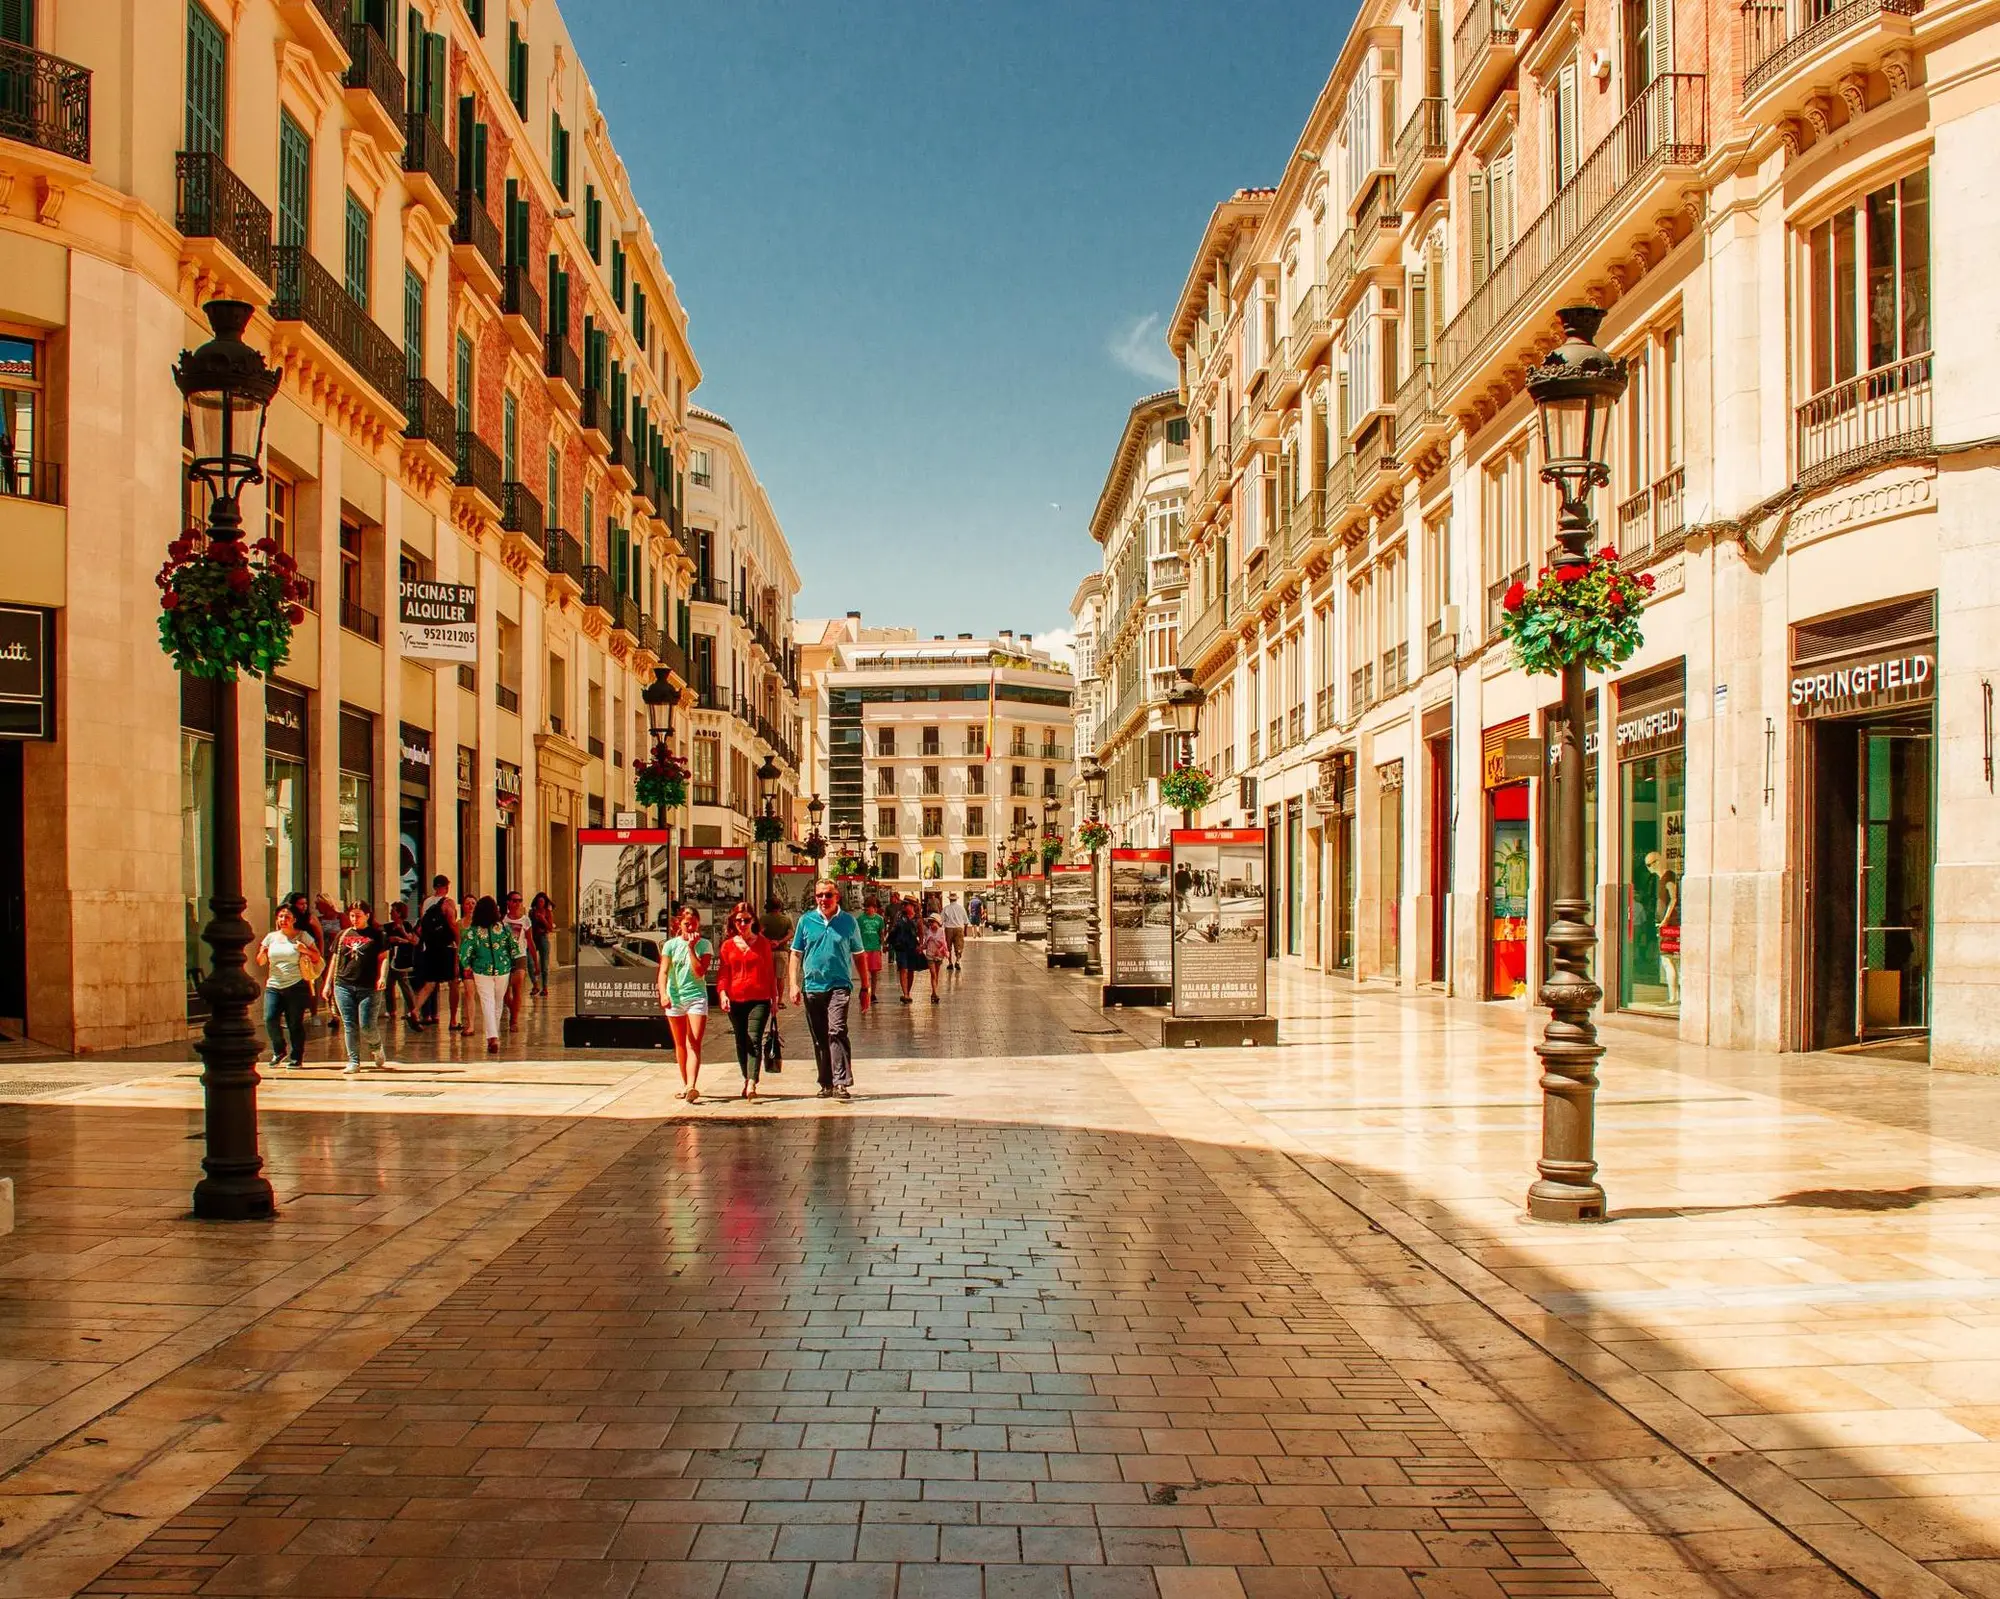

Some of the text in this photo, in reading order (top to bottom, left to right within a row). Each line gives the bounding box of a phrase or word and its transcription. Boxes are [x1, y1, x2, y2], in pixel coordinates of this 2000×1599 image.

[399, 581, 475, 605] OFICINAS EN
[406, 601, 466, 622] ALQUILER
[423, 628, 475, 643] 952121205
[0, 642, 32, 661] utti
[1791, 655, 1930, 706] SPRINGFIELD
[1616, 708, 1680, 746] SPRINGFIELD
[624, 981, 641, 990] AÑOS
[642, 982, 650, 990] DE
[1221, 982, 1238, 991] AÑOS
[1249, 983, 1258, 991] LA
